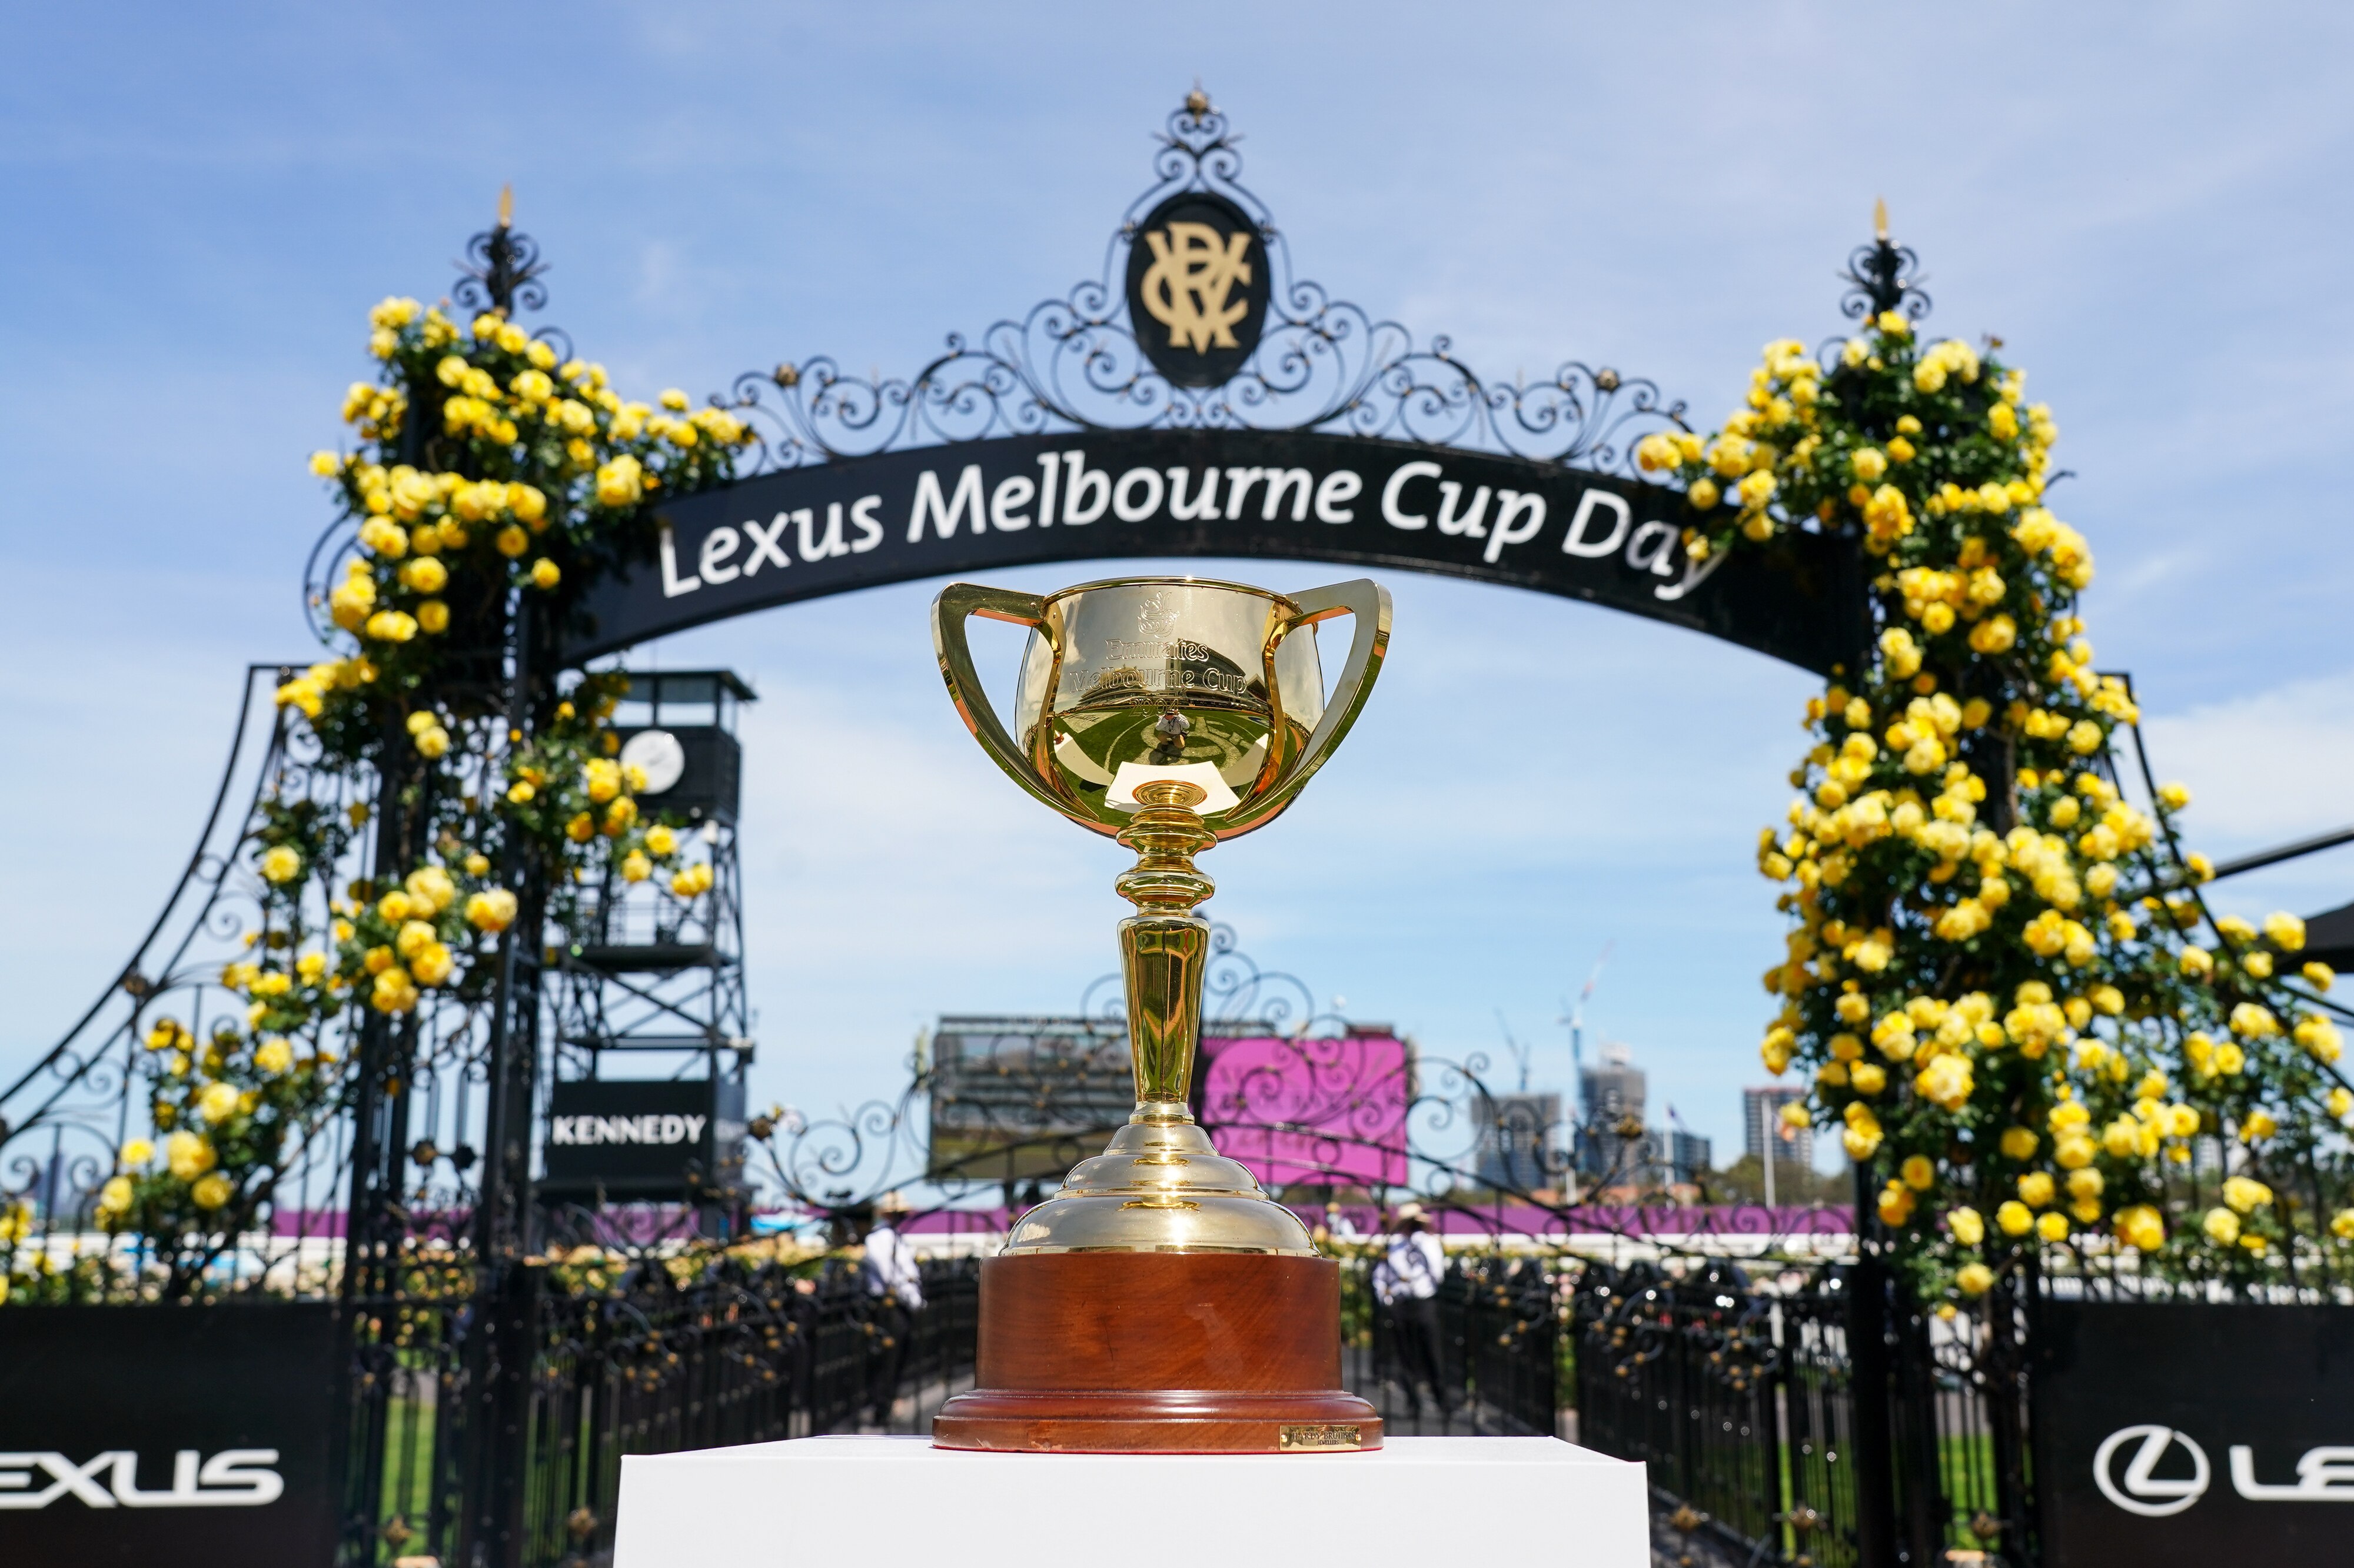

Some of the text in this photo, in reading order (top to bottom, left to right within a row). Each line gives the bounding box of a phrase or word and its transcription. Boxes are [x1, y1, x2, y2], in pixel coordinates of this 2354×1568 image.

[660, 449, 1724, 601] Lexus Melbourne Cup Day
[1105, 638, 1210, 663] Emirates
[1069, 667, 1248, 699] Melbourne Cup
[551, 1114, 707, 1145] KENNEDY
[1292, 1431, 1356, 1440] HARDY BROTHERS
[0, 1449, 284, 1509] EXUS
